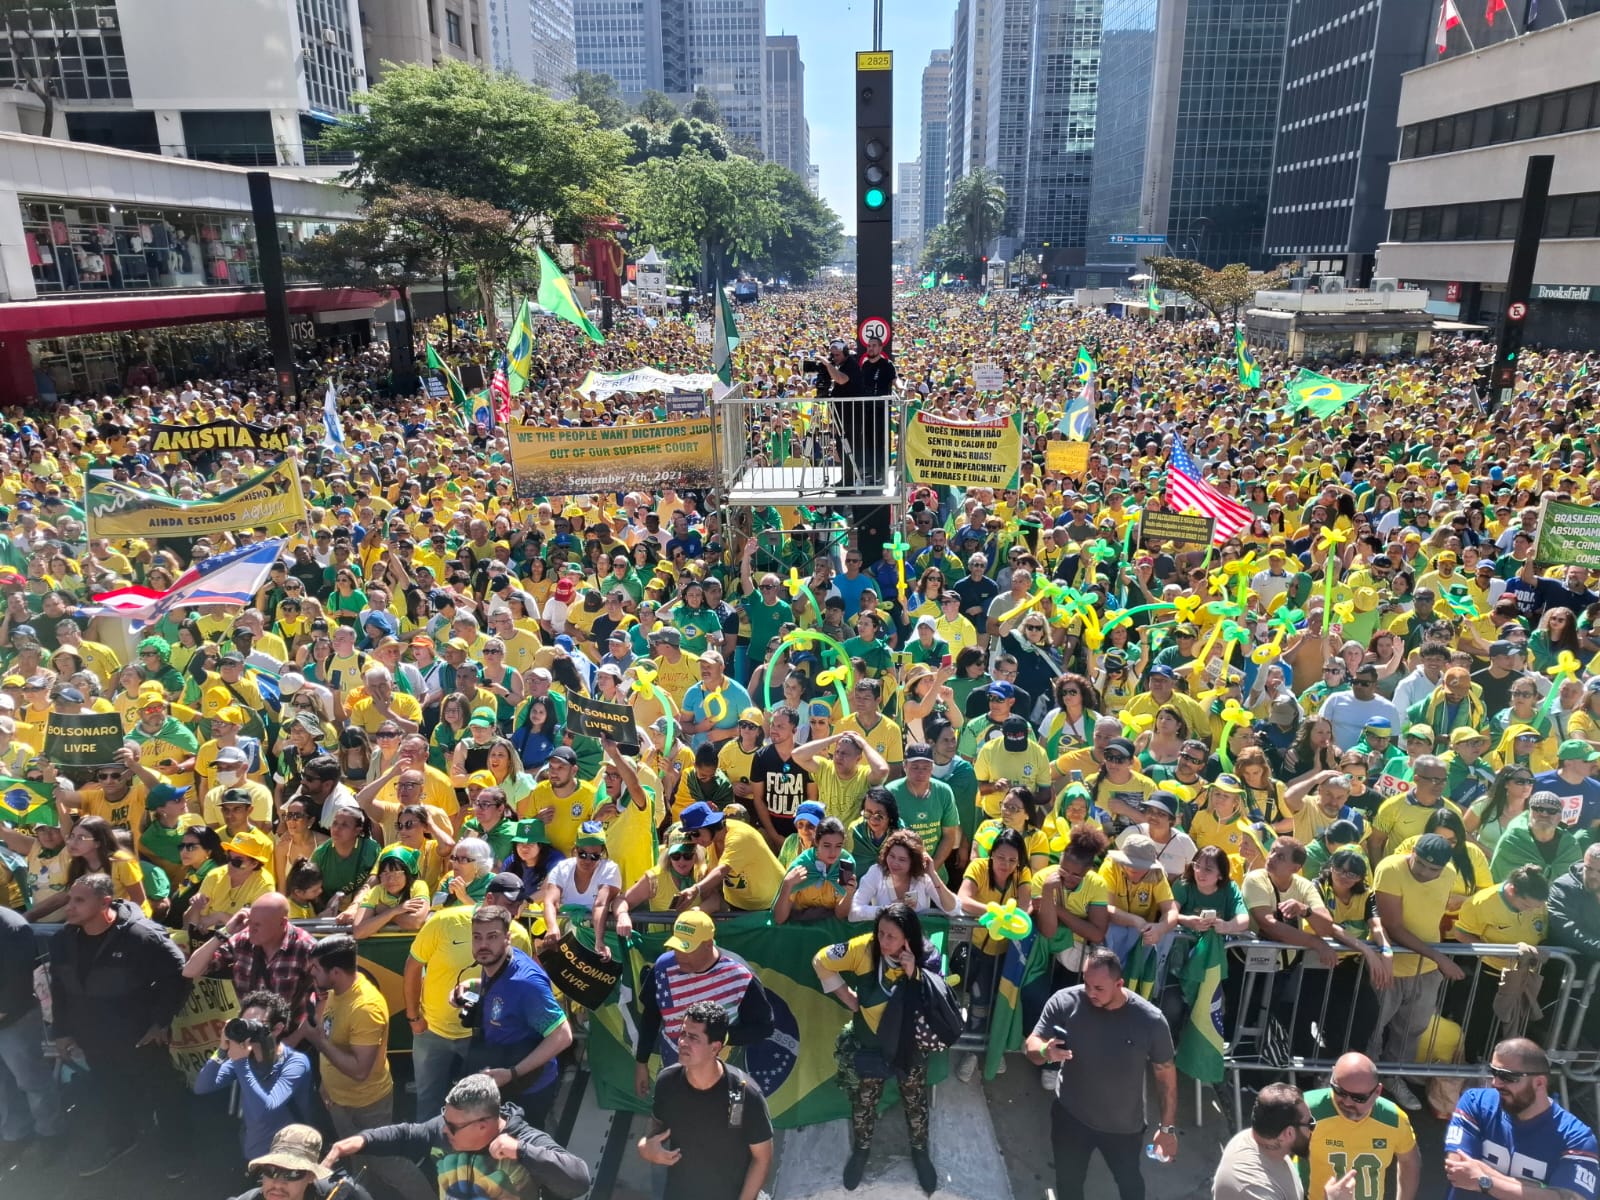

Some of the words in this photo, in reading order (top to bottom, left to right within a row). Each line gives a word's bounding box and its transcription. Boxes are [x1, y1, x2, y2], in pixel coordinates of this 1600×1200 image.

[867, 56, 889, 66] 2825
[1537, 285, 1591, 301] Brooksfield
[865, 323, 885, 339] 50
[517, 432, 533, 443] WE
[535, 431, 556, 442] THE
[559, 429, 598, 441] PEOPLE
[600, 429, 628, 440] WANT
[632, 426, 687, 439] DICTATORS
[924, 425, 949, 435] VOCÊS
[152, 426, 256, 451] ANISTIA
[927, 437, 953, 447] SENTIR
[954, 439, 960, 448] O
[961, 439, 985, 449] CALOR
[986, 441, 998, 449] DO
[550, 448, 570, 460] OUT
[572, 447, 586, 458] OF
[589, 446, 610, 458] OUR
[613, 444, 663, 457] SUPREME
[665, 442, 699, 454] COURT
[931, 449, 951, 459] POVO
[953, 450, 968, 459] NAS
[968, 451, 992, 461] RUAS!
[915, 458, 945, 469] PAUTEM
[946, 461, 951, 469] O
[953, 461, 1008, 473] IMPEACHMENT
[568, 474, 626, 487] September
[920, 470, 929, 478] DE
[930, 470, 962, 481] MORAES
[962, 473, 966, 481] E
[149, 514, 183, 527] AINDA
[187, 512, 236, 526] ESTAMOS
[1562, 540, 1576, 549] DE
[568, 700, 630, 723] BOLSONARO
[48, 725, 118, 737] BOLSONARO
[584, 720, 614, 732] LIVRE
[64, 743, 97, 753] LIVRE
[766, 771, 804, 795] FORA
[766, 792, 804, 815] LULA
[560, 943, 617, 985] BOLSONARO
[560, 968, 590, 991] LIVRE
[1327, 1151, 1383, 1200] 10
